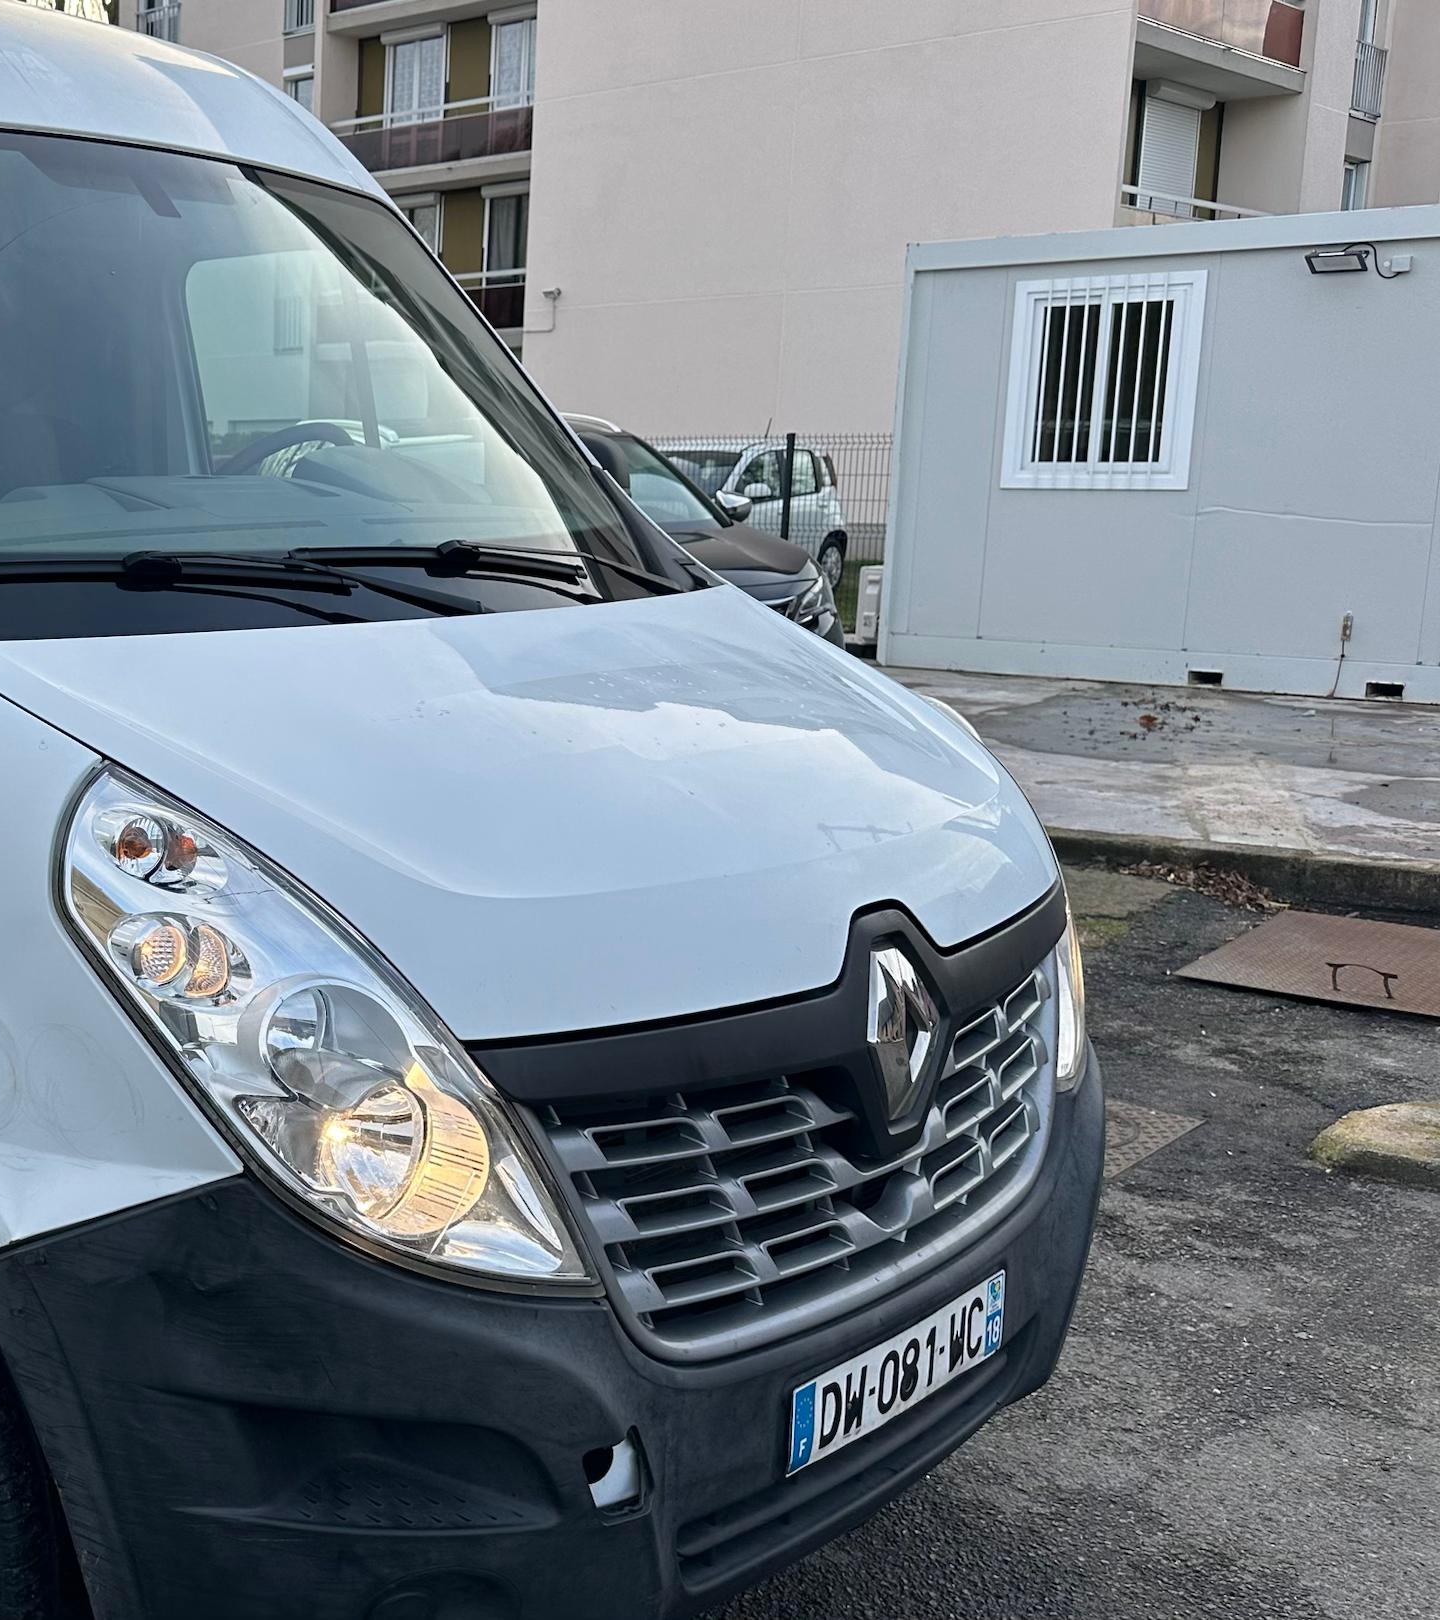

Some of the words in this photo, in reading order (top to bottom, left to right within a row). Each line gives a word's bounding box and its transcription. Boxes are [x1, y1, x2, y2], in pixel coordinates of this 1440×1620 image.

[986, 1315, 1001, 1347] 18
[818, 1297, 984, 1450] DW-081-WC
[798, 1437, 808, 1459] F
